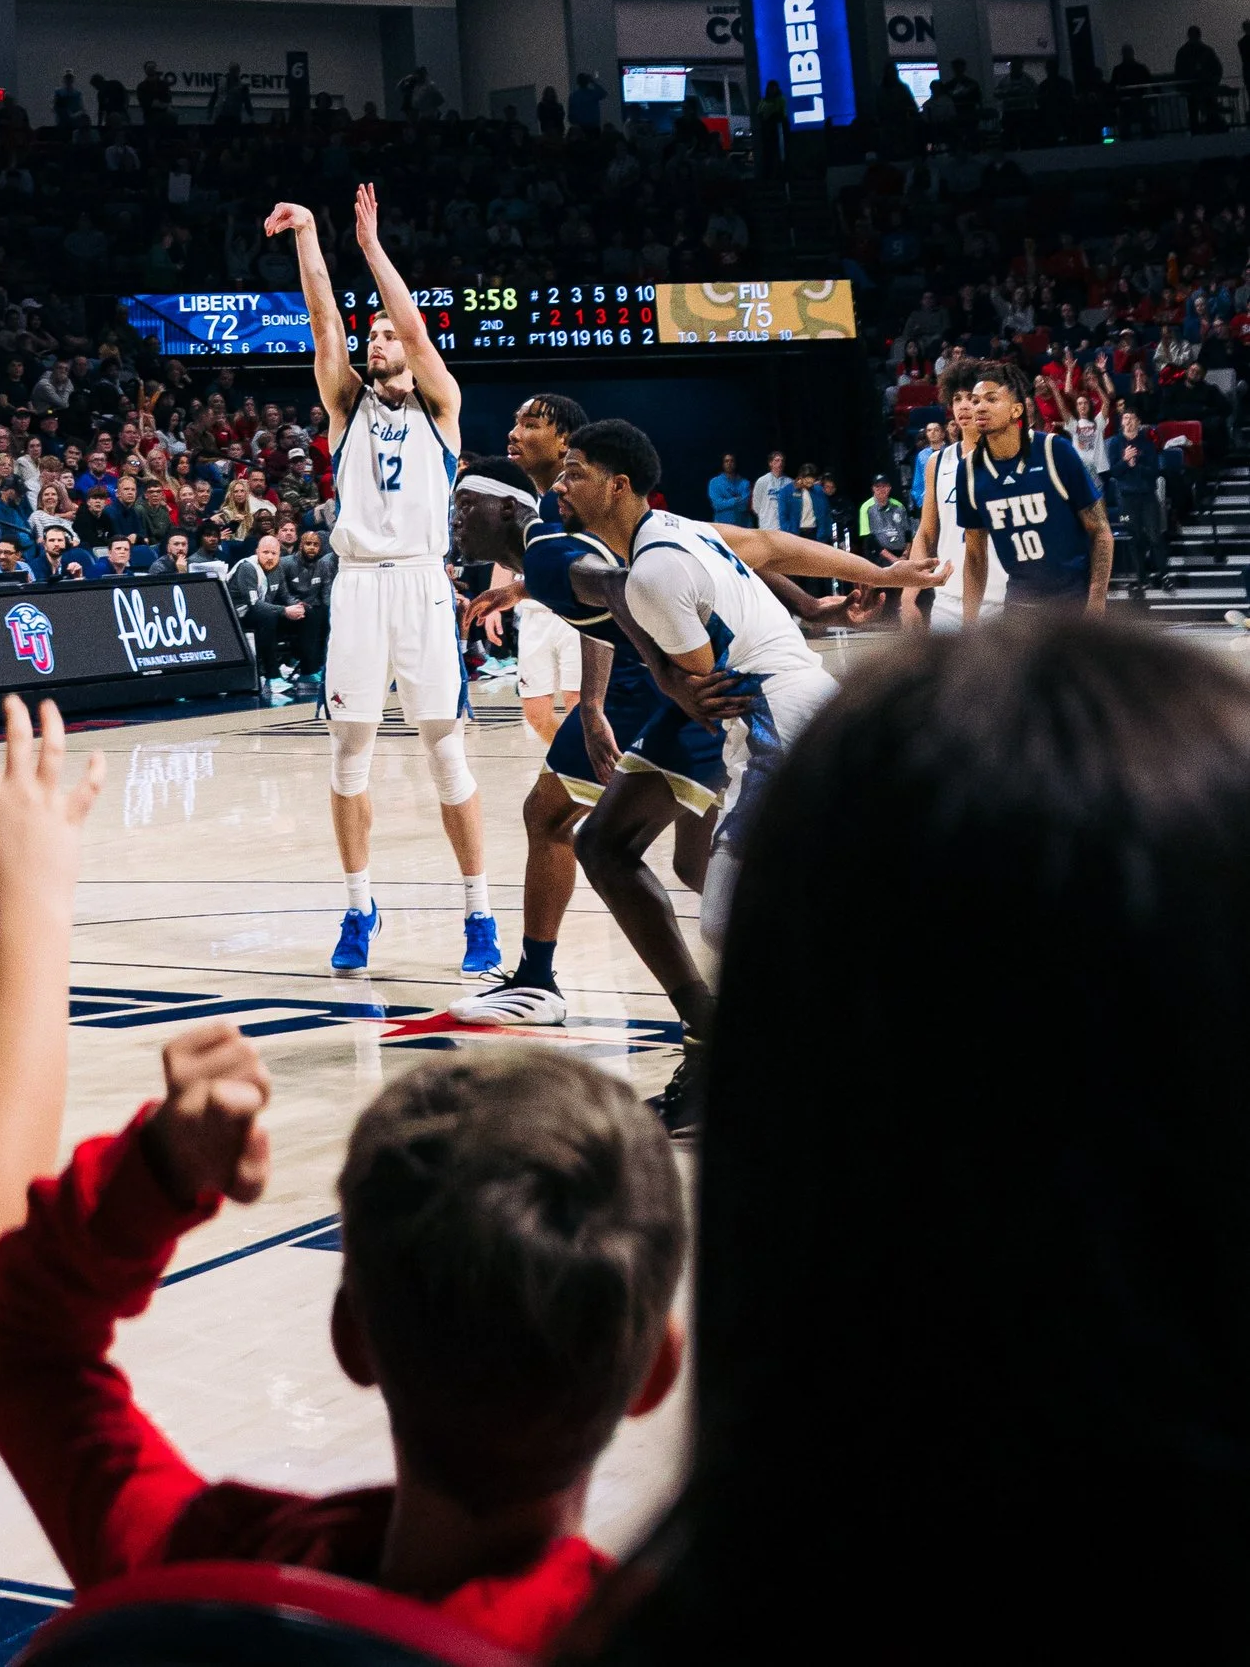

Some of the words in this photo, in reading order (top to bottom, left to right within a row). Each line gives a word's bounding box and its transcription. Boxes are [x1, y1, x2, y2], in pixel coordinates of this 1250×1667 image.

[1071, 16, 1087, 36] 7
[183, 72, 228, 87] VINE
[291, 62, 305, 79] 6
[344, 292, 356, 308] 3
[367, 292, 379, 307] 4
[432, 290, 454, 307] 25
[463, 288, 518, 312] 3:58
[548, 287, 560, 304] 2
[570, 287, 583, 303] 3
[593, 286, 605, 303] 5
[616, 286, 628, 302] 9
[634, 285, 655, 302] 10
[738, 283, 769, 300] FIU
[179, 294, 260, 312] LIBERTY
[262, 314, 307, 326] BONUS
[348, 314, 357, 330] 1
[439, 312, 450, 328] 3
[531, 312, 540, 324] F
[550, 309, 561, 326] 2
[575, 309, 583, 325] 1
[596, 308, 607, 324] 3
[618, 307, 629, 324] 2
[640, 307, 652, 323] 0
[738, 302, 773, 328] 75
[203, 314, 239, 341] 72
[480, 319, 504, 331] 2ND
[437, 333, 455, 349] 11
[529, 333, 546, 345] PT
[548, 330, 568, 347] 19
[570, 330, 591, 346] 19
[593, 329, 614, 346] 16
[619, 328, 631, 345] 6
[642, 328, 654, 345] 2
[708, 331, 717, 343] 2
[728, 330, 770, 342] FOULS
[779, 329, 793, 340] 10
[241, 343, 250, 353] 6
[298, 342, 306, 352] 3
[378, 452, 402, 491] 12
[985, 492, 1048, 530] FIU
[1011, 530, 1045, 562] 10
[113, 585, 207, 672] Abich
[137, 653, 180, 667] FINANCIAL
[180, 649, 217, 664] SERVICES
